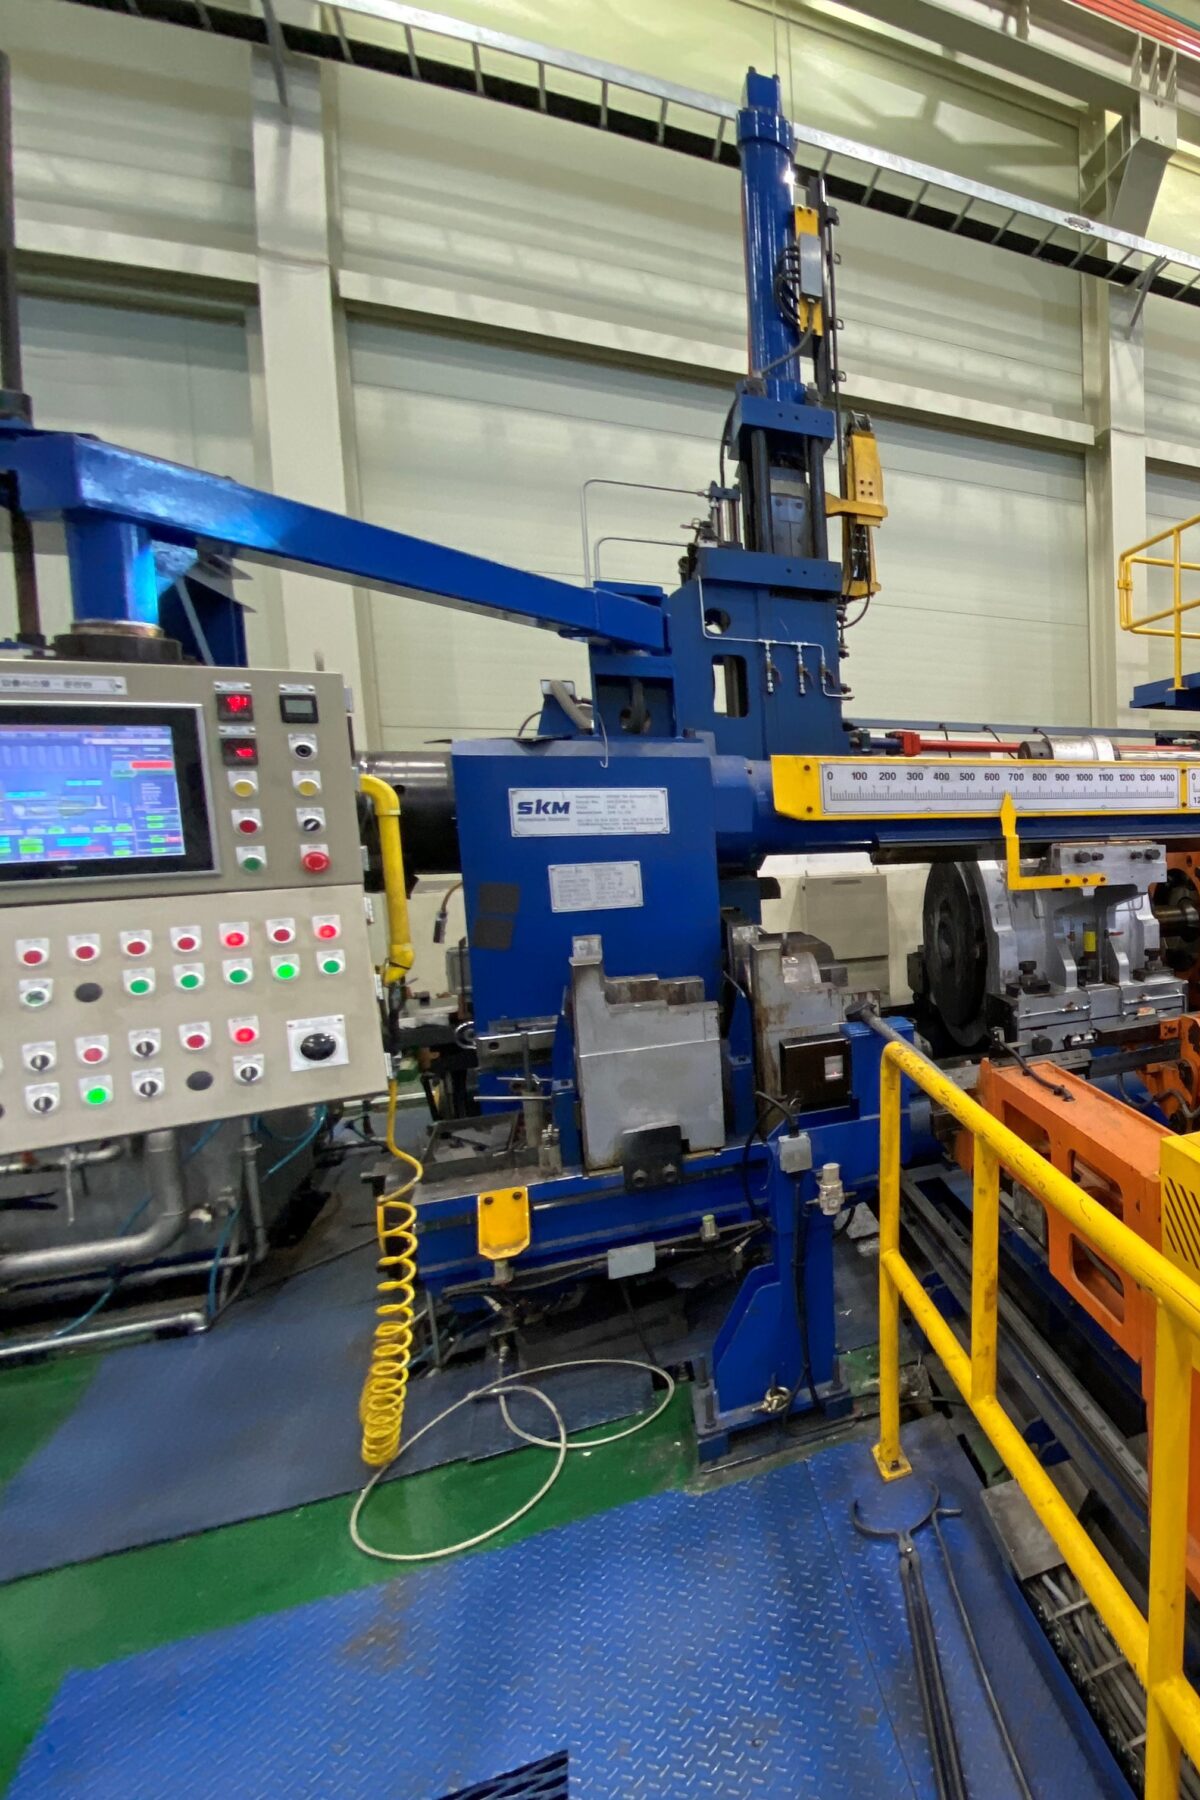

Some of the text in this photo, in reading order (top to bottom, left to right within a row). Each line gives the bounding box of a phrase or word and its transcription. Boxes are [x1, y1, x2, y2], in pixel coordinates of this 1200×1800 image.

[827, 771, 1175, 781] 0 100 200 300 400 500 600 700 800 900 1000 1100 1200 1300 1400
[517, 799, 570, 815] SKM
